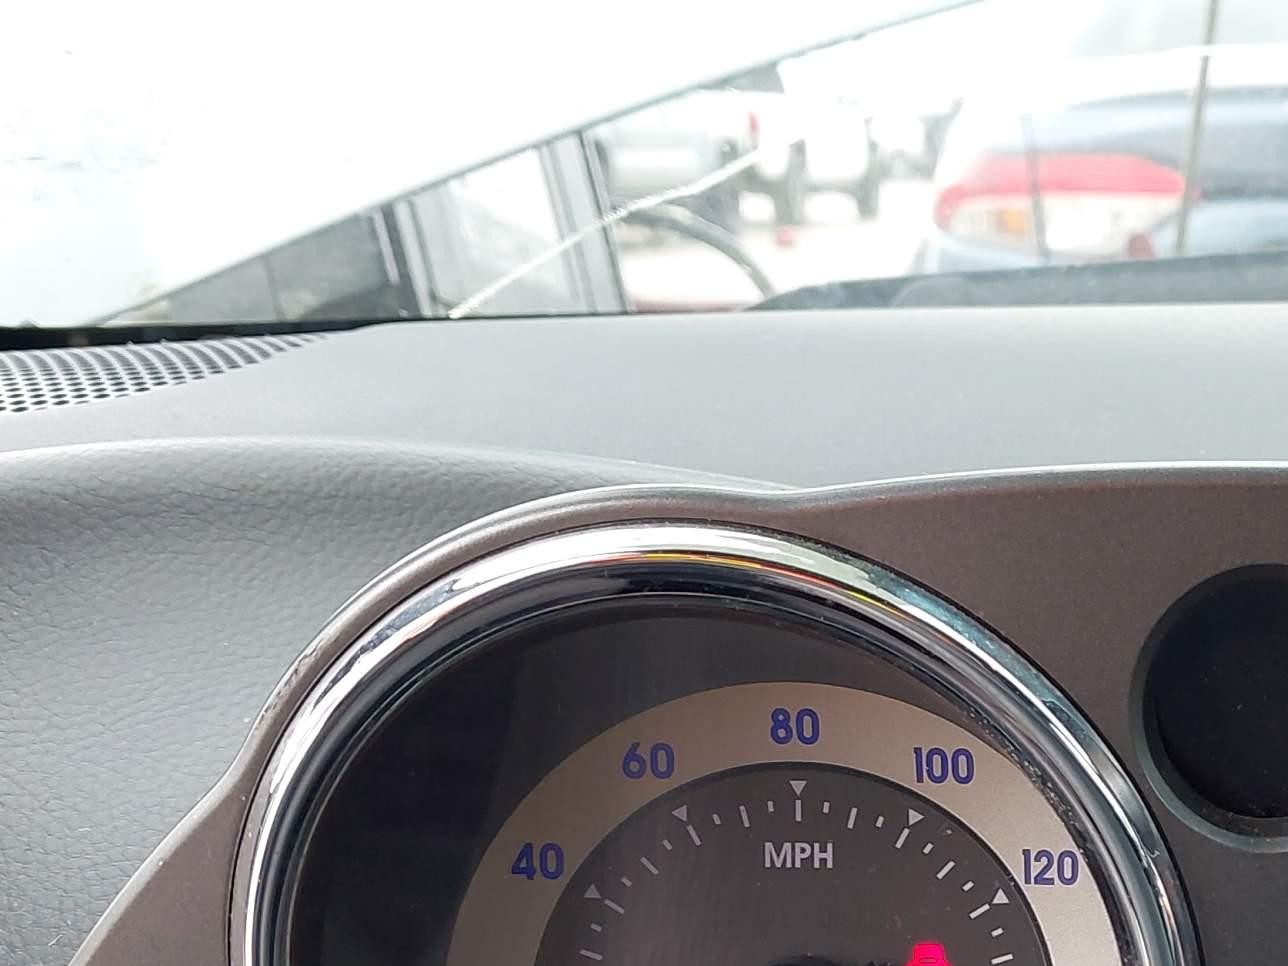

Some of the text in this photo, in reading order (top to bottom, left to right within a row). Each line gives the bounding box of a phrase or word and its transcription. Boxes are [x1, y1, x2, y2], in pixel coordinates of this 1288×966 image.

[770, 709, 820, 746] 80
[622, 742, 675, 780] 60
[913, 747, 975, 785] 100
[510, 842, 565, 879] 40
[763, 842, 834, 869] MPH
[1022, 849, 1080, 886] 120
